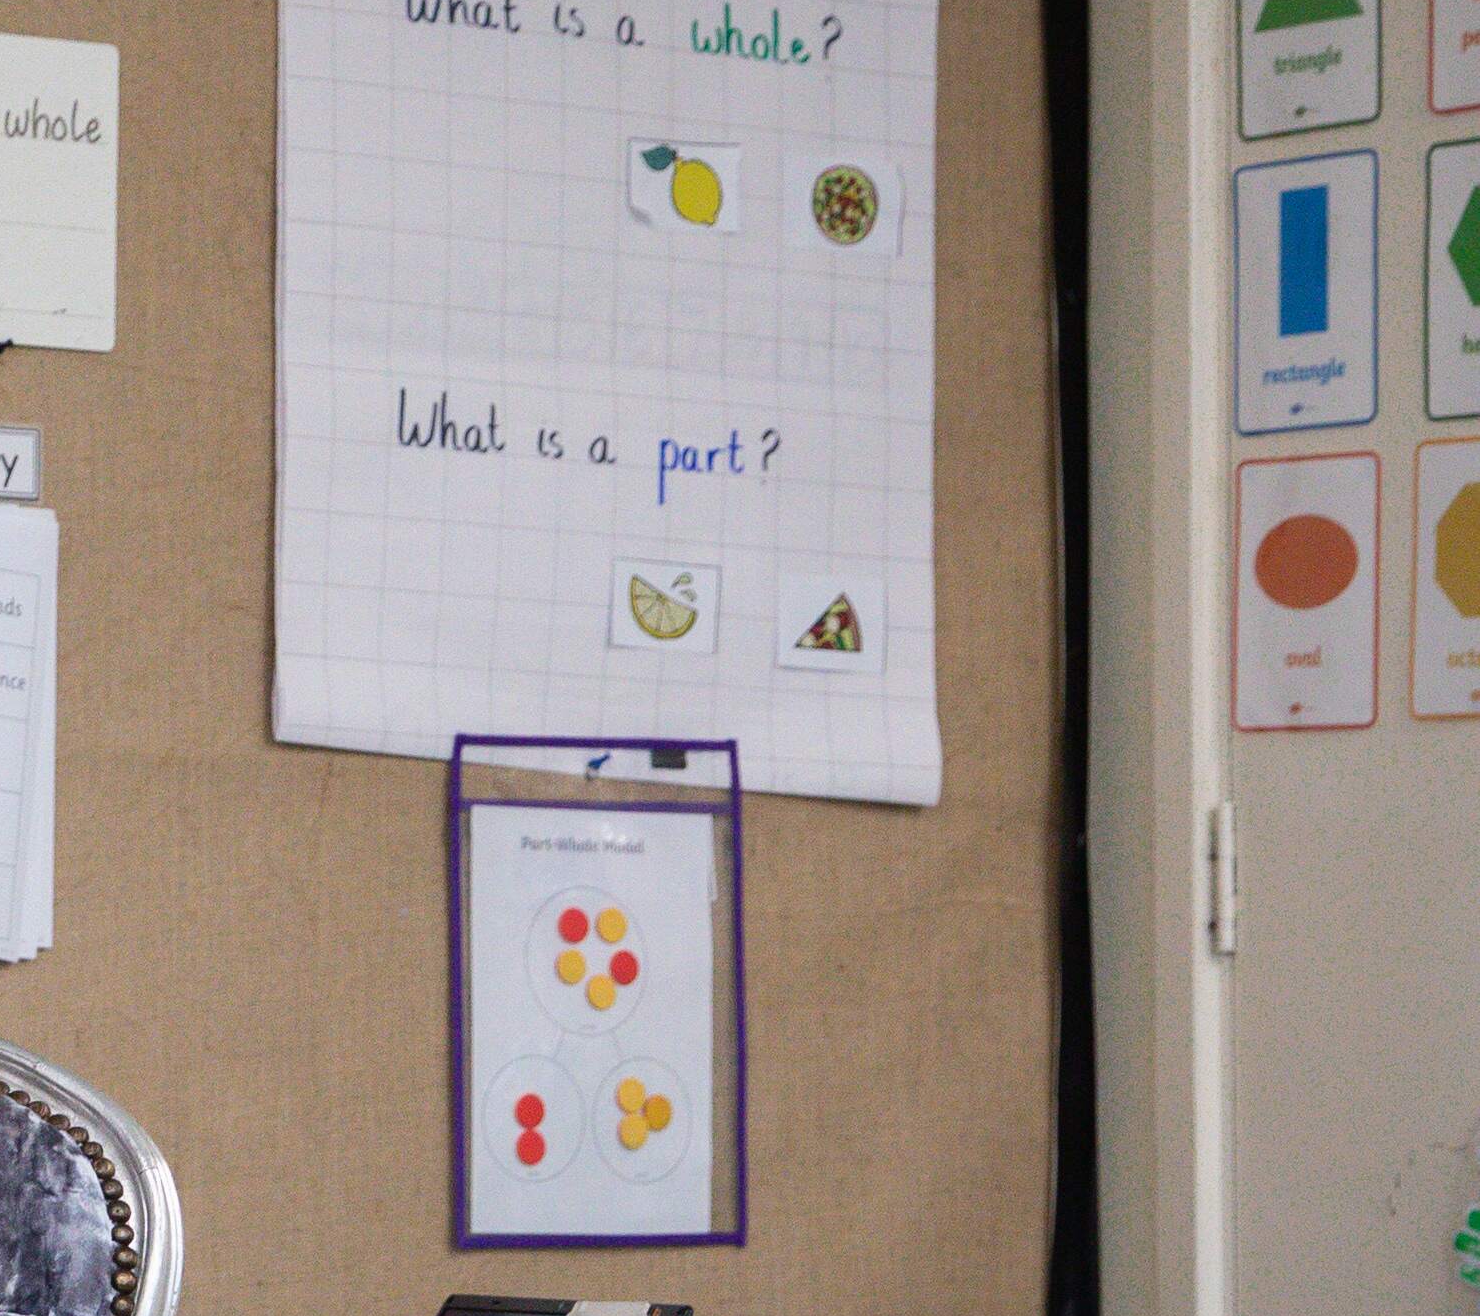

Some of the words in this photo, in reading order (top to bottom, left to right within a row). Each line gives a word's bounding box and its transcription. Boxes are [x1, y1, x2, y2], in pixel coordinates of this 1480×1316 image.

[553, 4, 585, 38] is
[616, 15, 644, 47] a
[4, 98, 102, 145] whole
[397, 388, 505, 454] What
[537, 429, 564, 460] is
[588, 436, 616, 465] a
